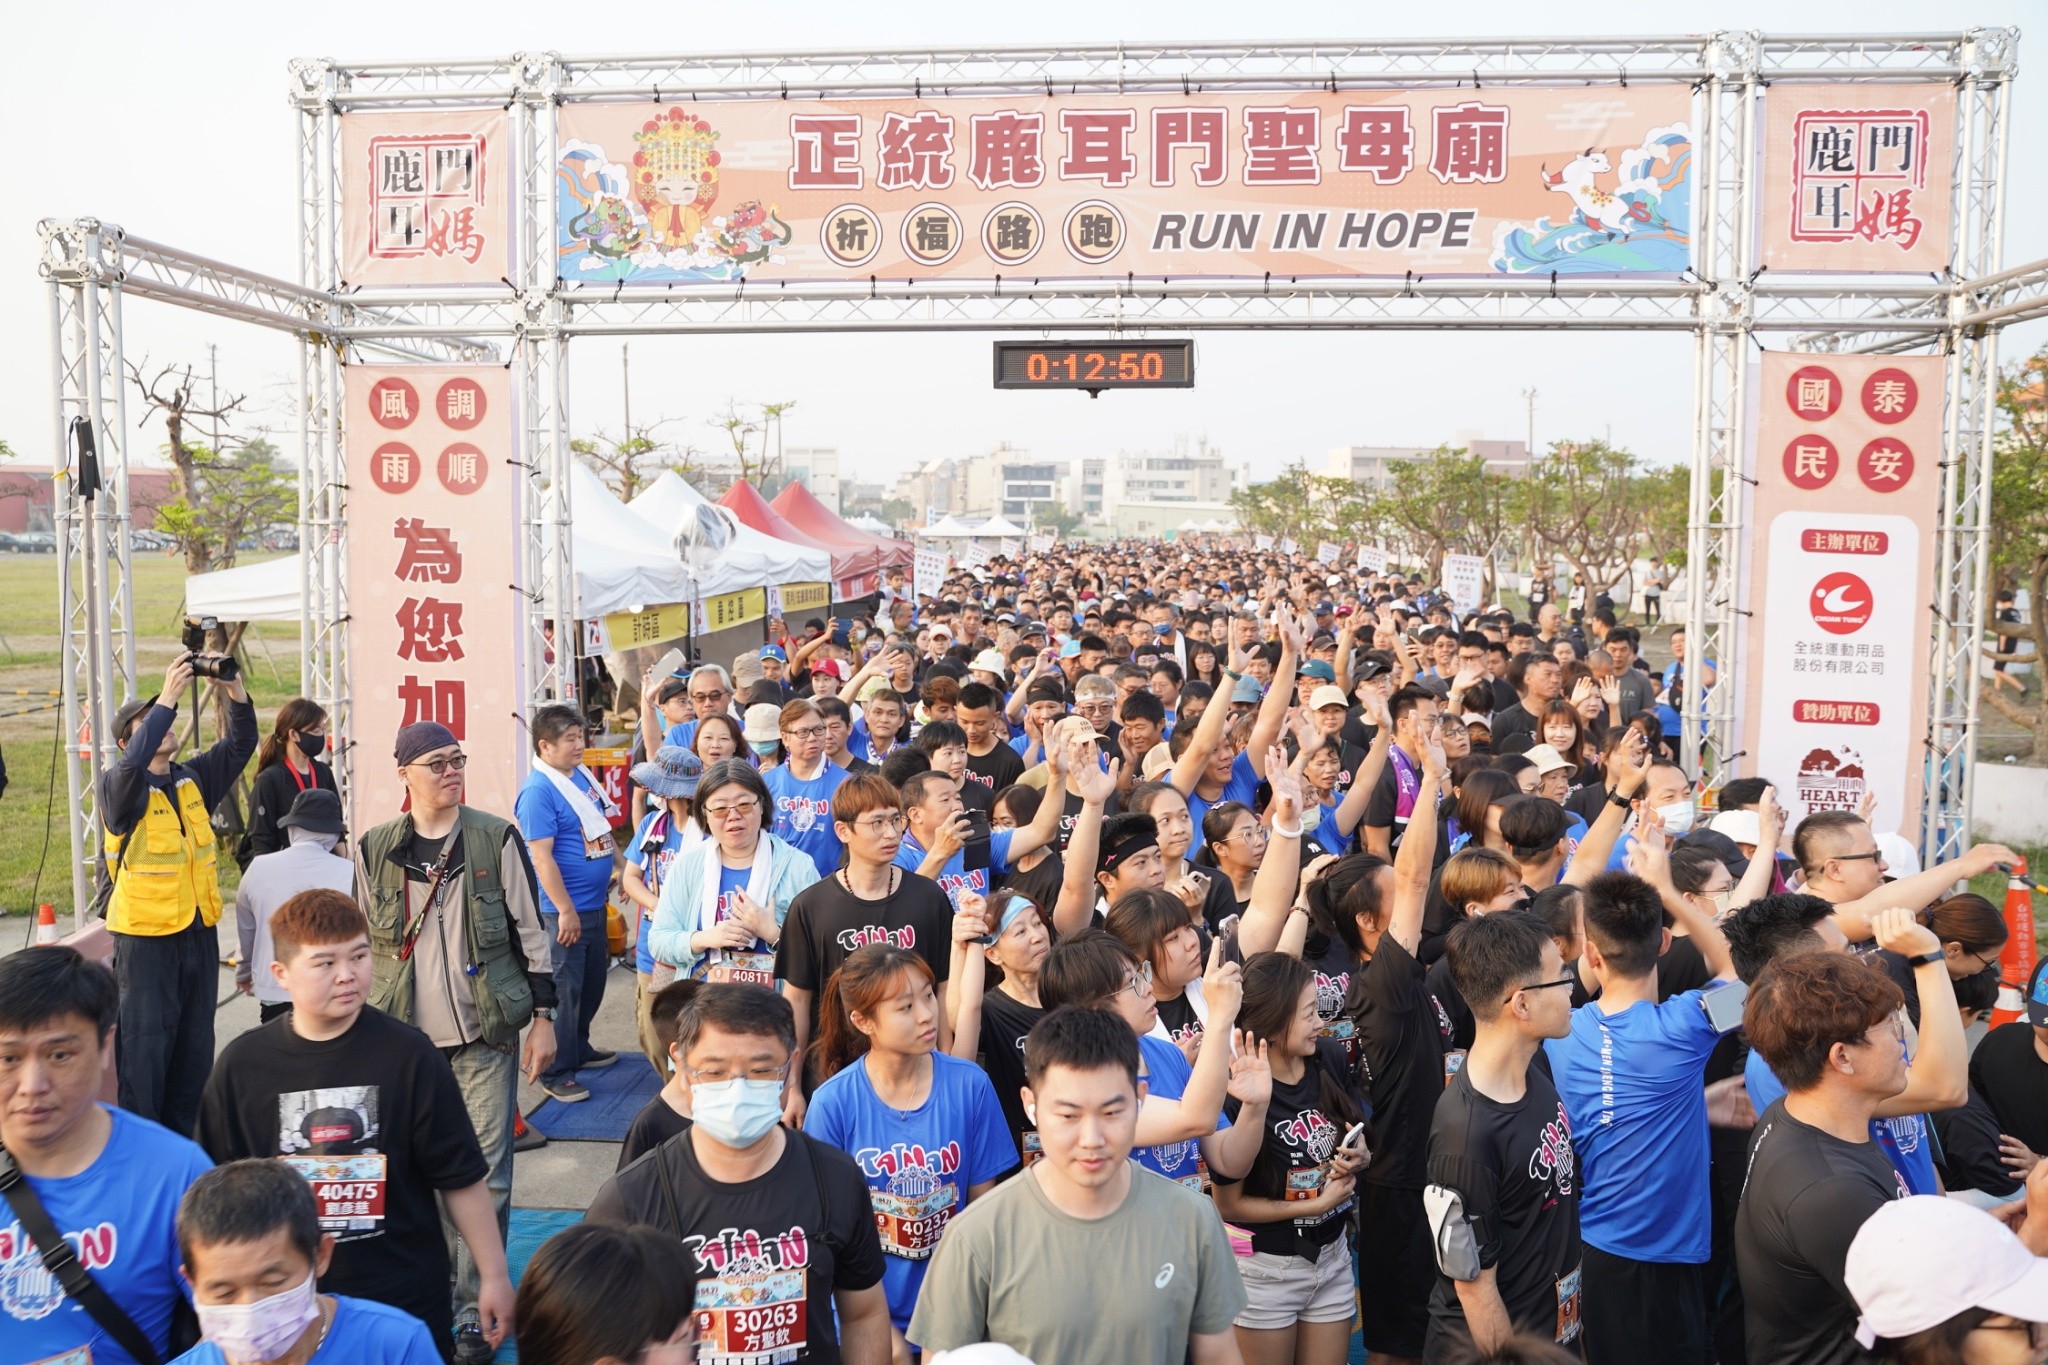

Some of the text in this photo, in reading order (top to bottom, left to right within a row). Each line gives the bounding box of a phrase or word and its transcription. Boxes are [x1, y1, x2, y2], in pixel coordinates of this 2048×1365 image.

[789, 102, 1510, 191] 正統鹿耳門聖母廟
[835, 213, 1114, 252] 祈福路跑
[1151, 209, 1477, 249] RUN IN HOPE
[1027, 353, 1163, 380] 0:12:50
[1809, 533, 1880, 552] 主辦單位
[1814, 615, 1841, 623] CHUAN
[1794, 641, 1885, 658] 全統運動用品
[1793, 658, 1884, 675] 股份有限公司
[1800, 789, 1860, 802] HEART
[732, 970, 769, 984] 40811
[856, 1141, 961, 1178] TAINAN
[317, 1183, 378, 1200] 40475
[902, 1209, 950, 1236] 40232
[734, 1304, 798, 1333] 30263
[744, 1327, 790, 1351] 方聖欽
